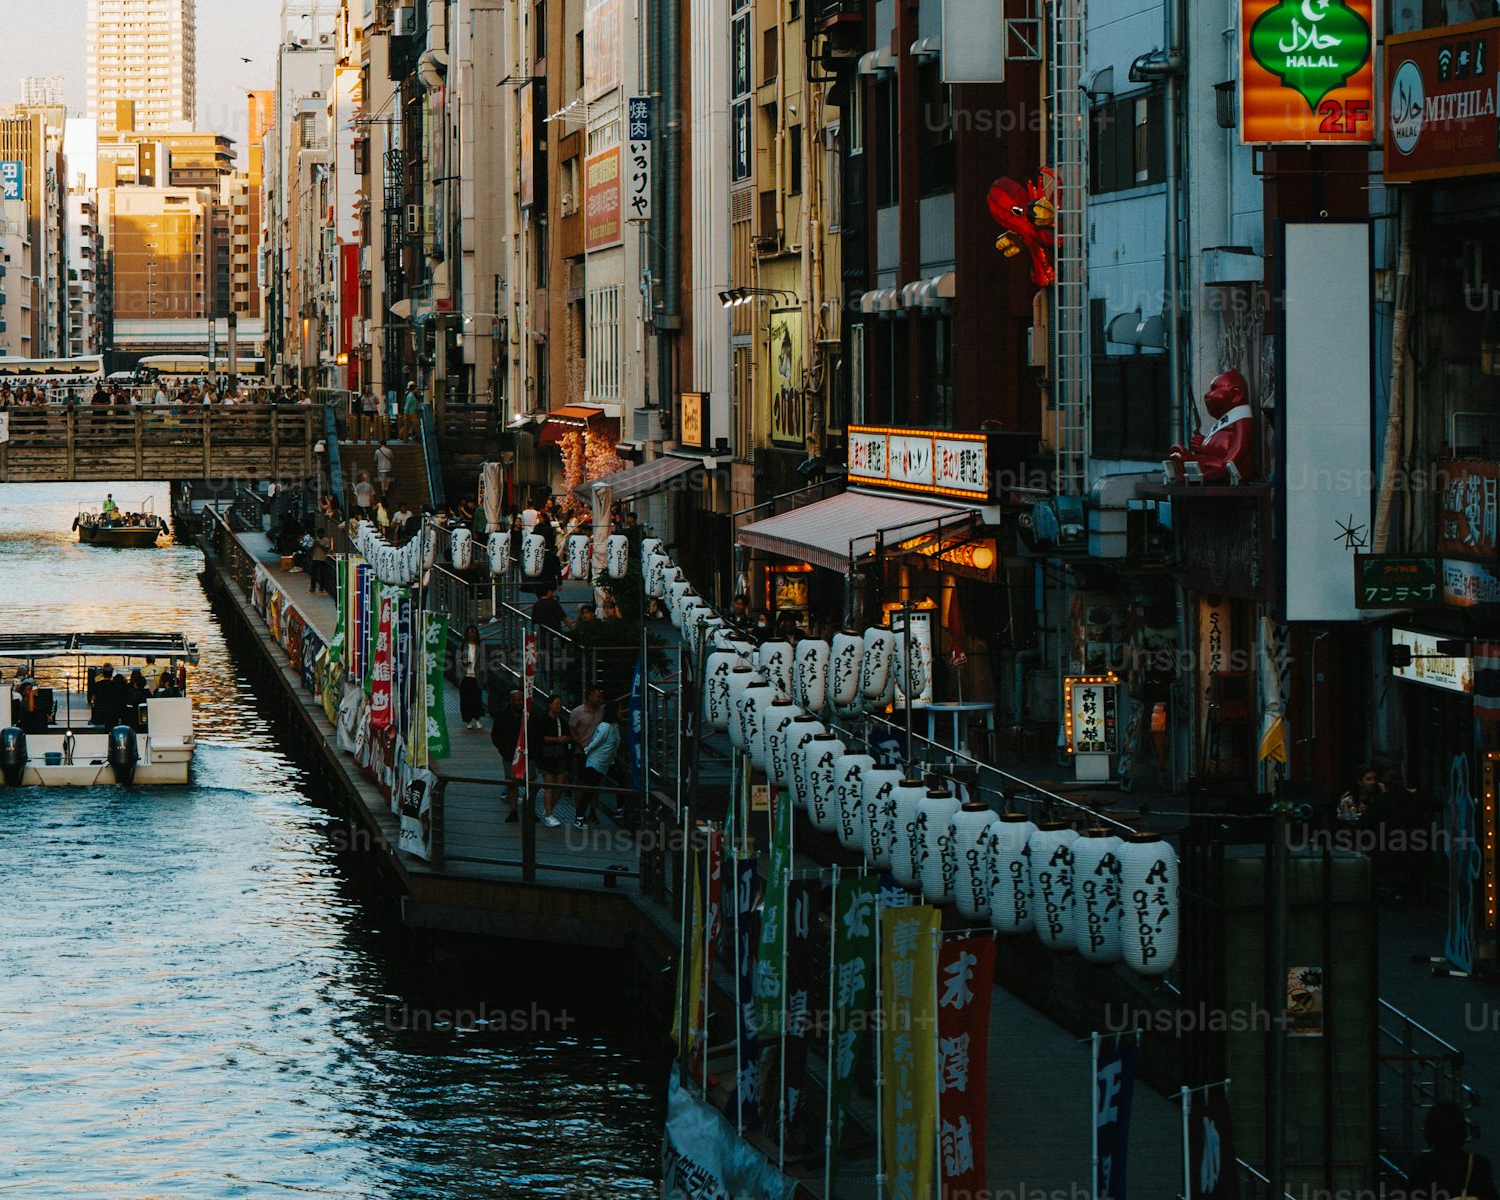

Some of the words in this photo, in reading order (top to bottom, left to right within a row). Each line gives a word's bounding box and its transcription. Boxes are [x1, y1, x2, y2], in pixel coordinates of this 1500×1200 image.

[1278, 17, 1342, 54] حلال
[1285, 55, 1339, 68] HALAL
[630, 101, 649, 138] 焼肉
[1319, 99, 1370, 134] 2F
[1393, 80, 1422, 125] حلال
[1425, 88, 1495, 123] MITHILA
[1396, 123, 1418, 139] HALAL
[631, 142, 648, 218] いろりや
[1082, 688, 1099, 742] お好み焼
[1132, 889, 1157, 966] group
